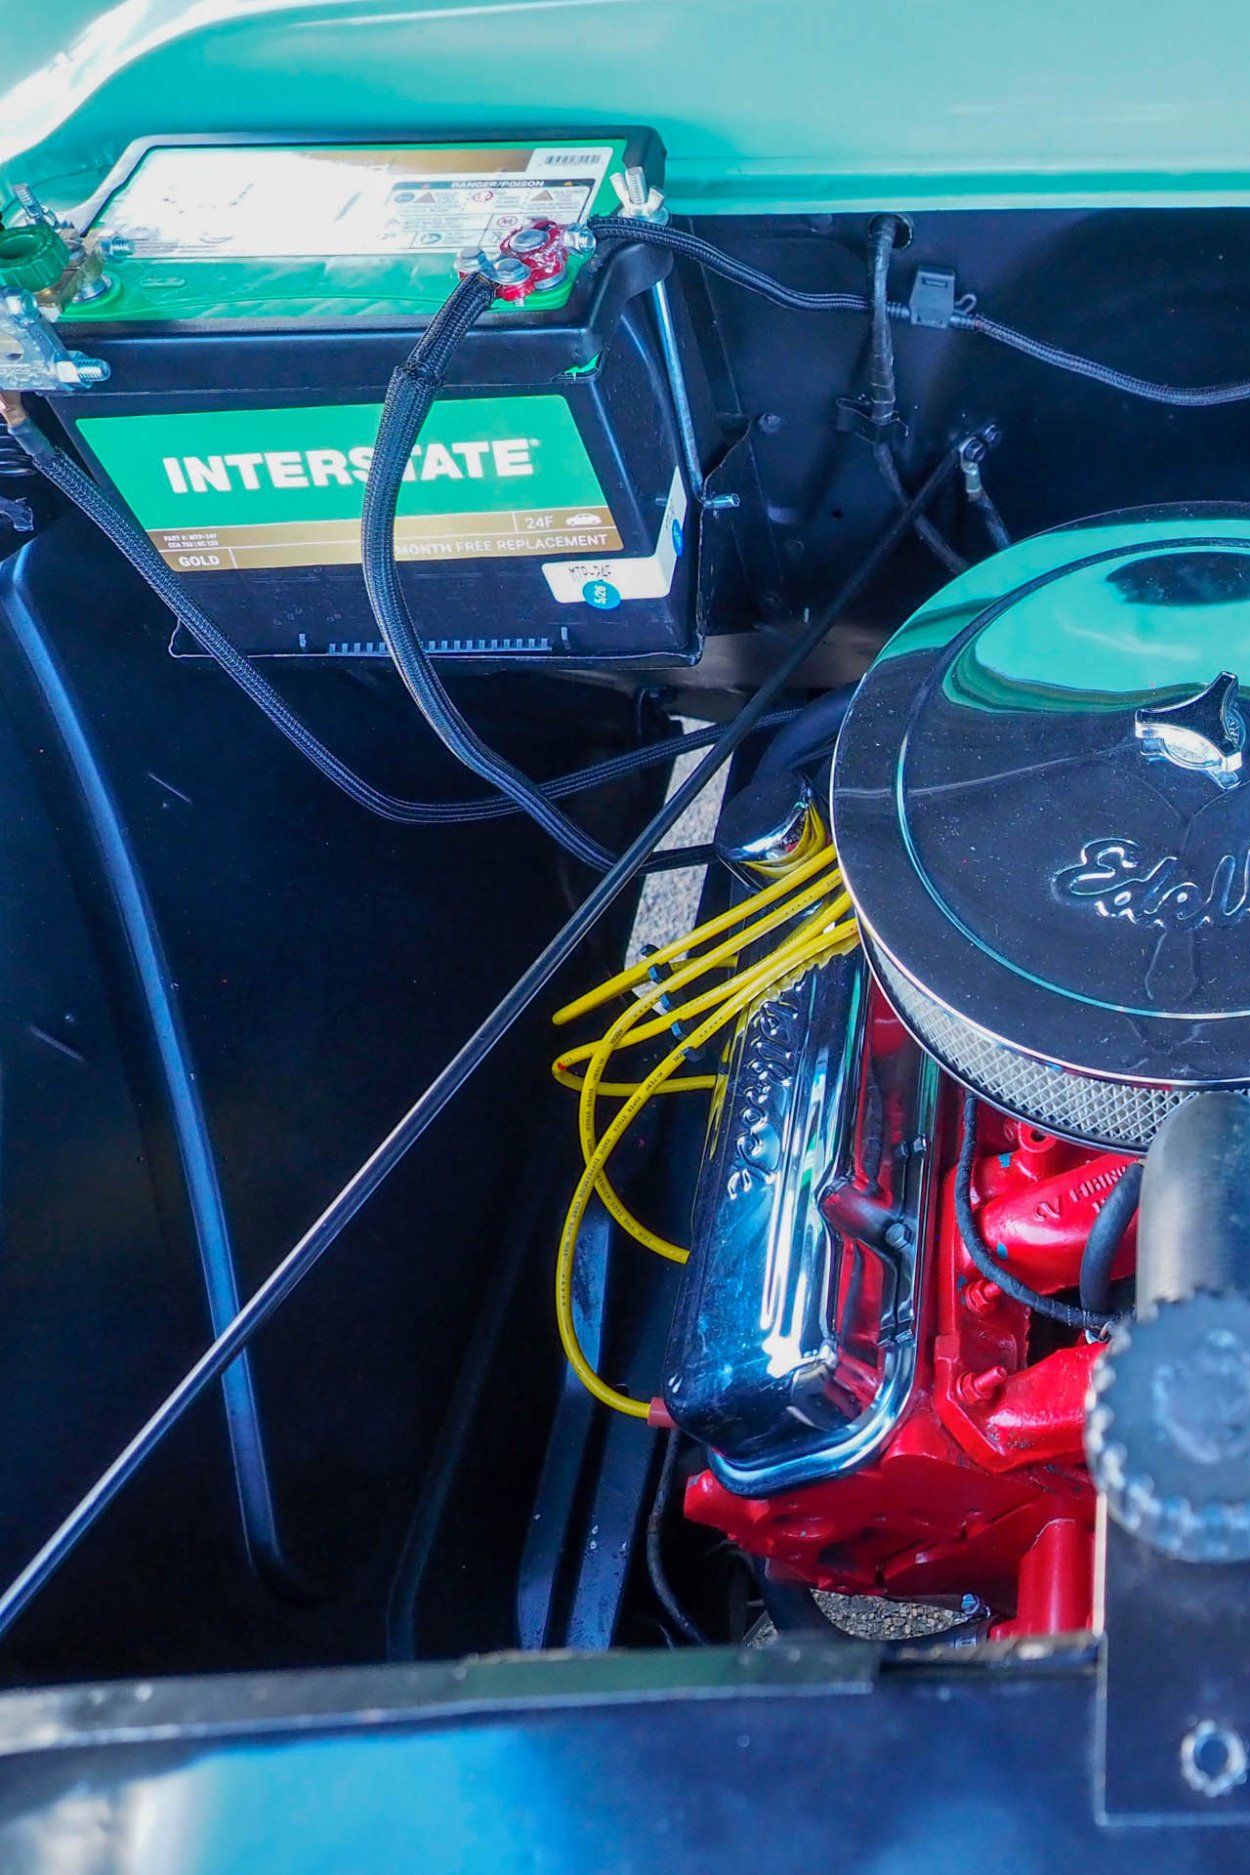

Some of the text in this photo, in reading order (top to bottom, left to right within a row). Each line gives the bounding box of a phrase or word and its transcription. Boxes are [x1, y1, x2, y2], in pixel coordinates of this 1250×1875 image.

[525, 515, 553, 529] 24F
[456, 540, 492, 553] FREE
[496, 533, 609, 551] REPLACEMENT
[178, 555, 220, 567] GOLD
